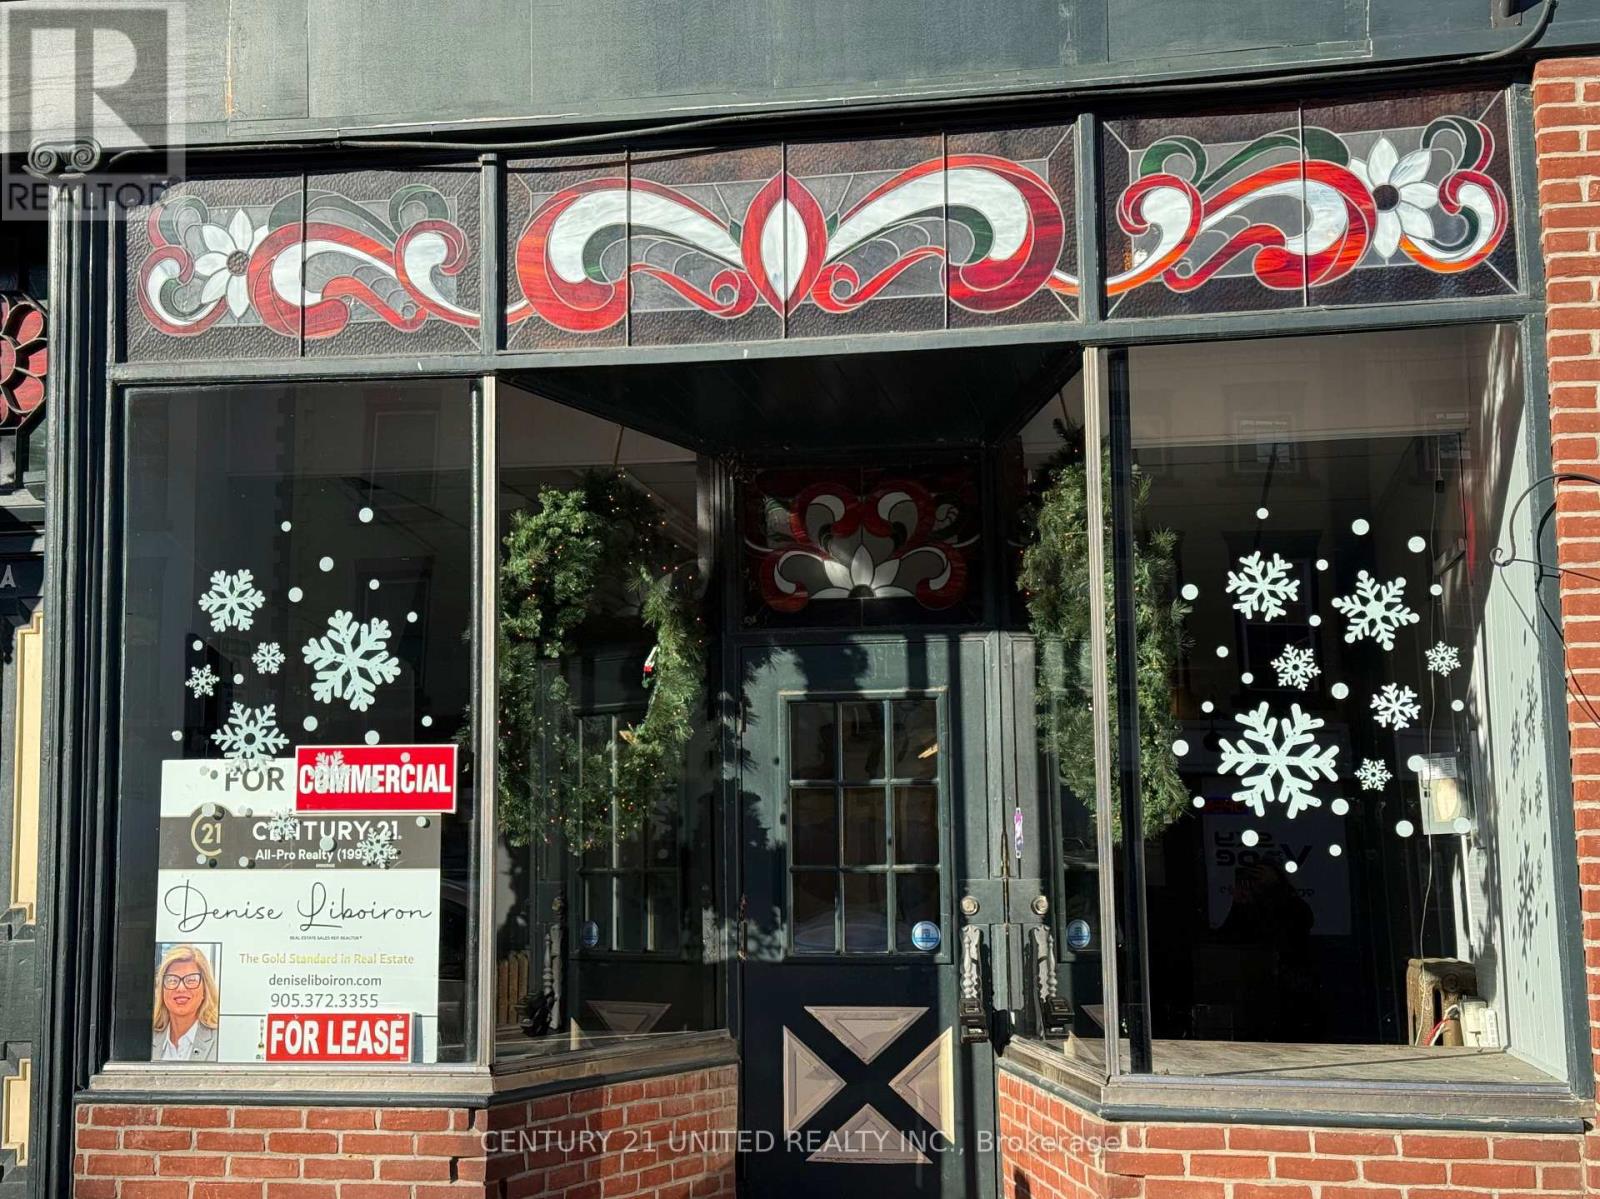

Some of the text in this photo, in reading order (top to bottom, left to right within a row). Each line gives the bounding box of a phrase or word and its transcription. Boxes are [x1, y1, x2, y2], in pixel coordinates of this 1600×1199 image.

[225, 766, 285, 792] FOR
[299, 763, 452, 795] COMMERCIAL
[254, 848, 296, 861] All-Pro
[298, 847, 334, 863] Realty
[164, 879, 433, 933] Denise Liboiron
[239, 953, 414, 965] The Gold Standard in Real Estate
[268, 973, 382, 987] deniseliboiron.com
[270, 993, 379, 1008] 905.372.3355
[270, 1019, 320, 1056] FOR
[327, 1019, 405, 1055] LEASE
